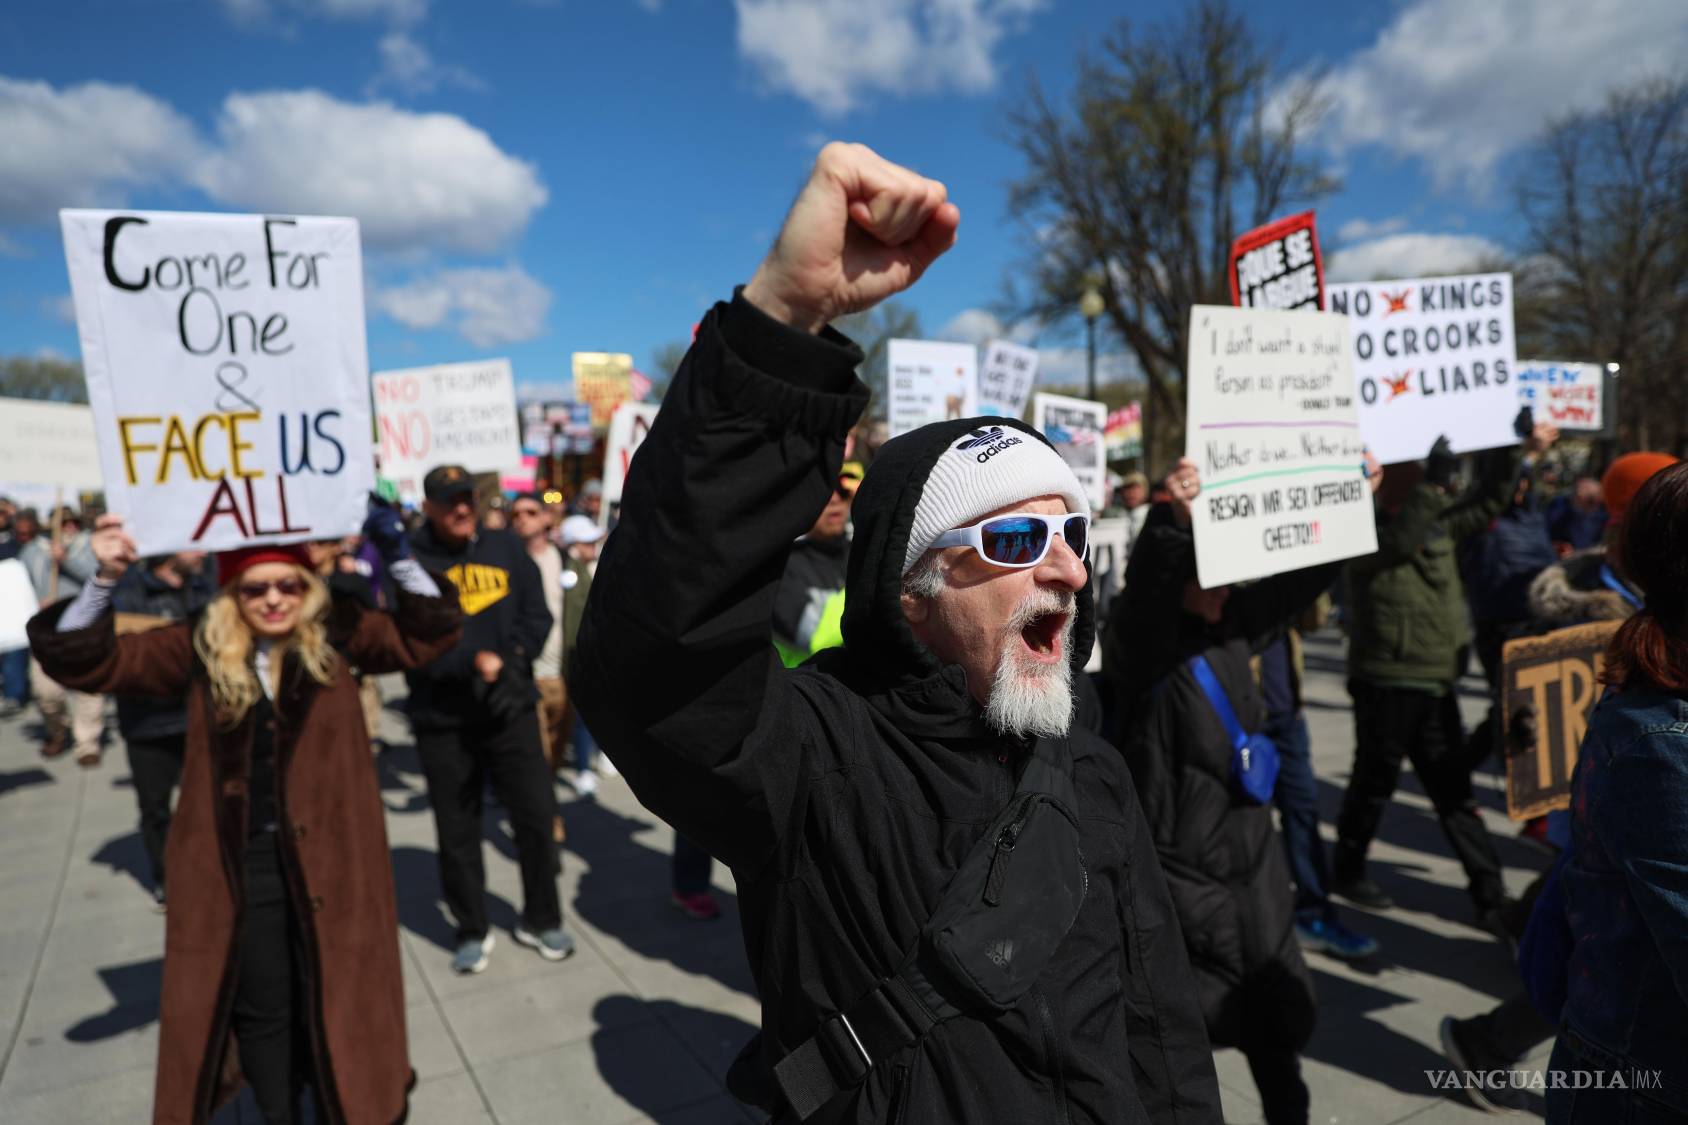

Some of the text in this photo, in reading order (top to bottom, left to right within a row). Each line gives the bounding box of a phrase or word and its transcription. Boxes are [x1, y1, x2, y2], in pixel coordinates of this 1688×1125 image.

[103, 216, 331, 291] Come For
[1284, 228, 1315, 269] SE
[1331, 281, 1503, 317] NO KINGS
[178, 286, 295, 356] One
[1384, 319, 1502, 357] CROOKS
[214, 361, 264, 413] &
[376, 374, 421, 404] NO
[1419, 360, 1509, 396] LIARS
[116, 409, 346, 487] FACE US
[378, 409, 432, 464] NO
[976, 436, 1023, 464] adidas
[190, 473, 312, 542] ALL
[1209, 493, 1257, 522] RESIGN
[1288, 484, 1310, 512] SEX
[1313, 479, 1363, 507] OFFENDER
